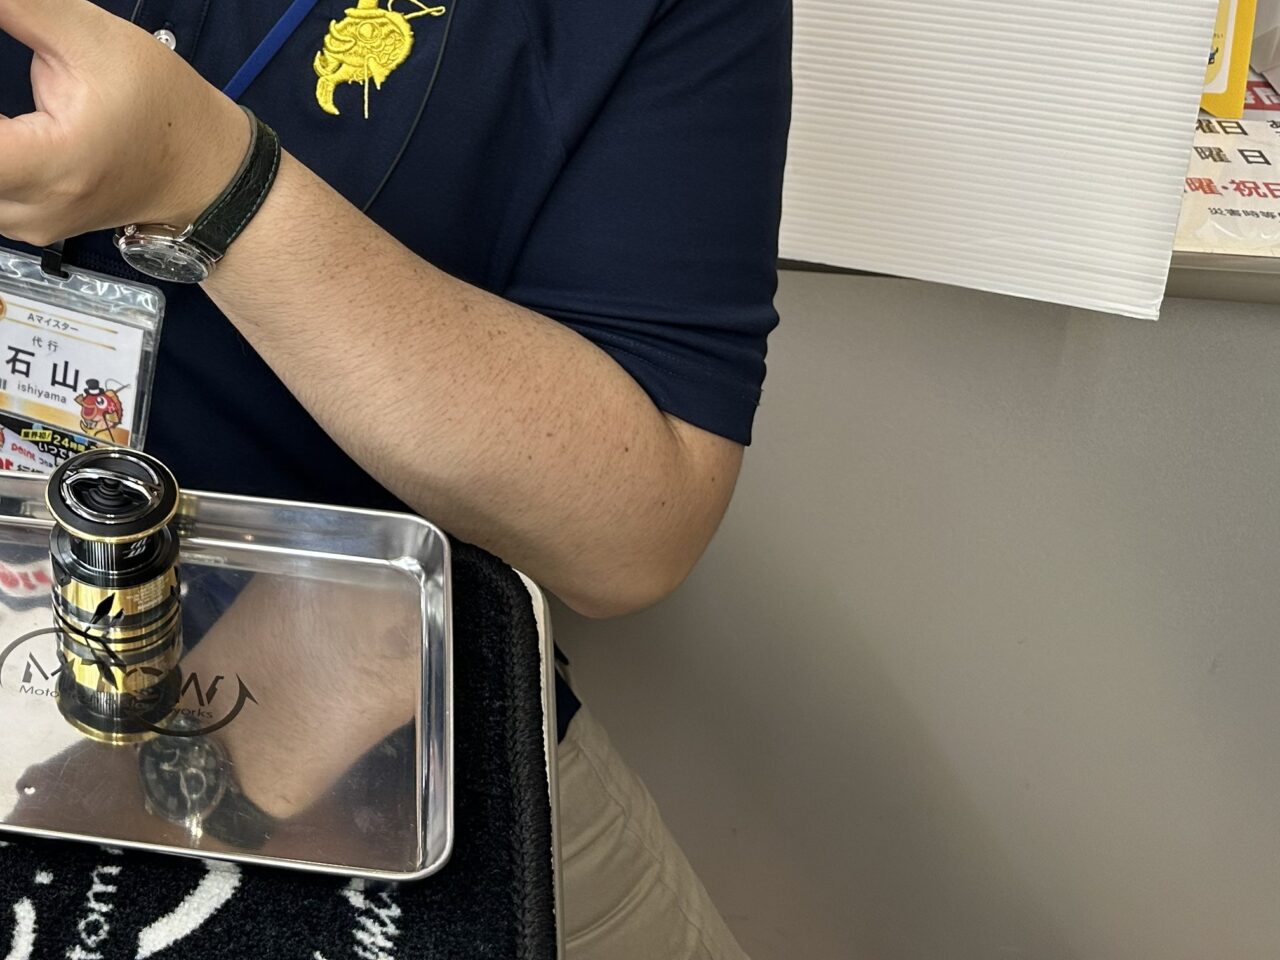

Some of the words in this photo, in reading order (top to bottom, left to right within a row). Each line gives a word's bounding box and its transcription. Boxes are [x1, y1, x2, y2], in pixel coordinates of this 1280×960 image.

[27, 313, 79, 332] Aマイスター
[17, 383, 67, 404] ishiyama
